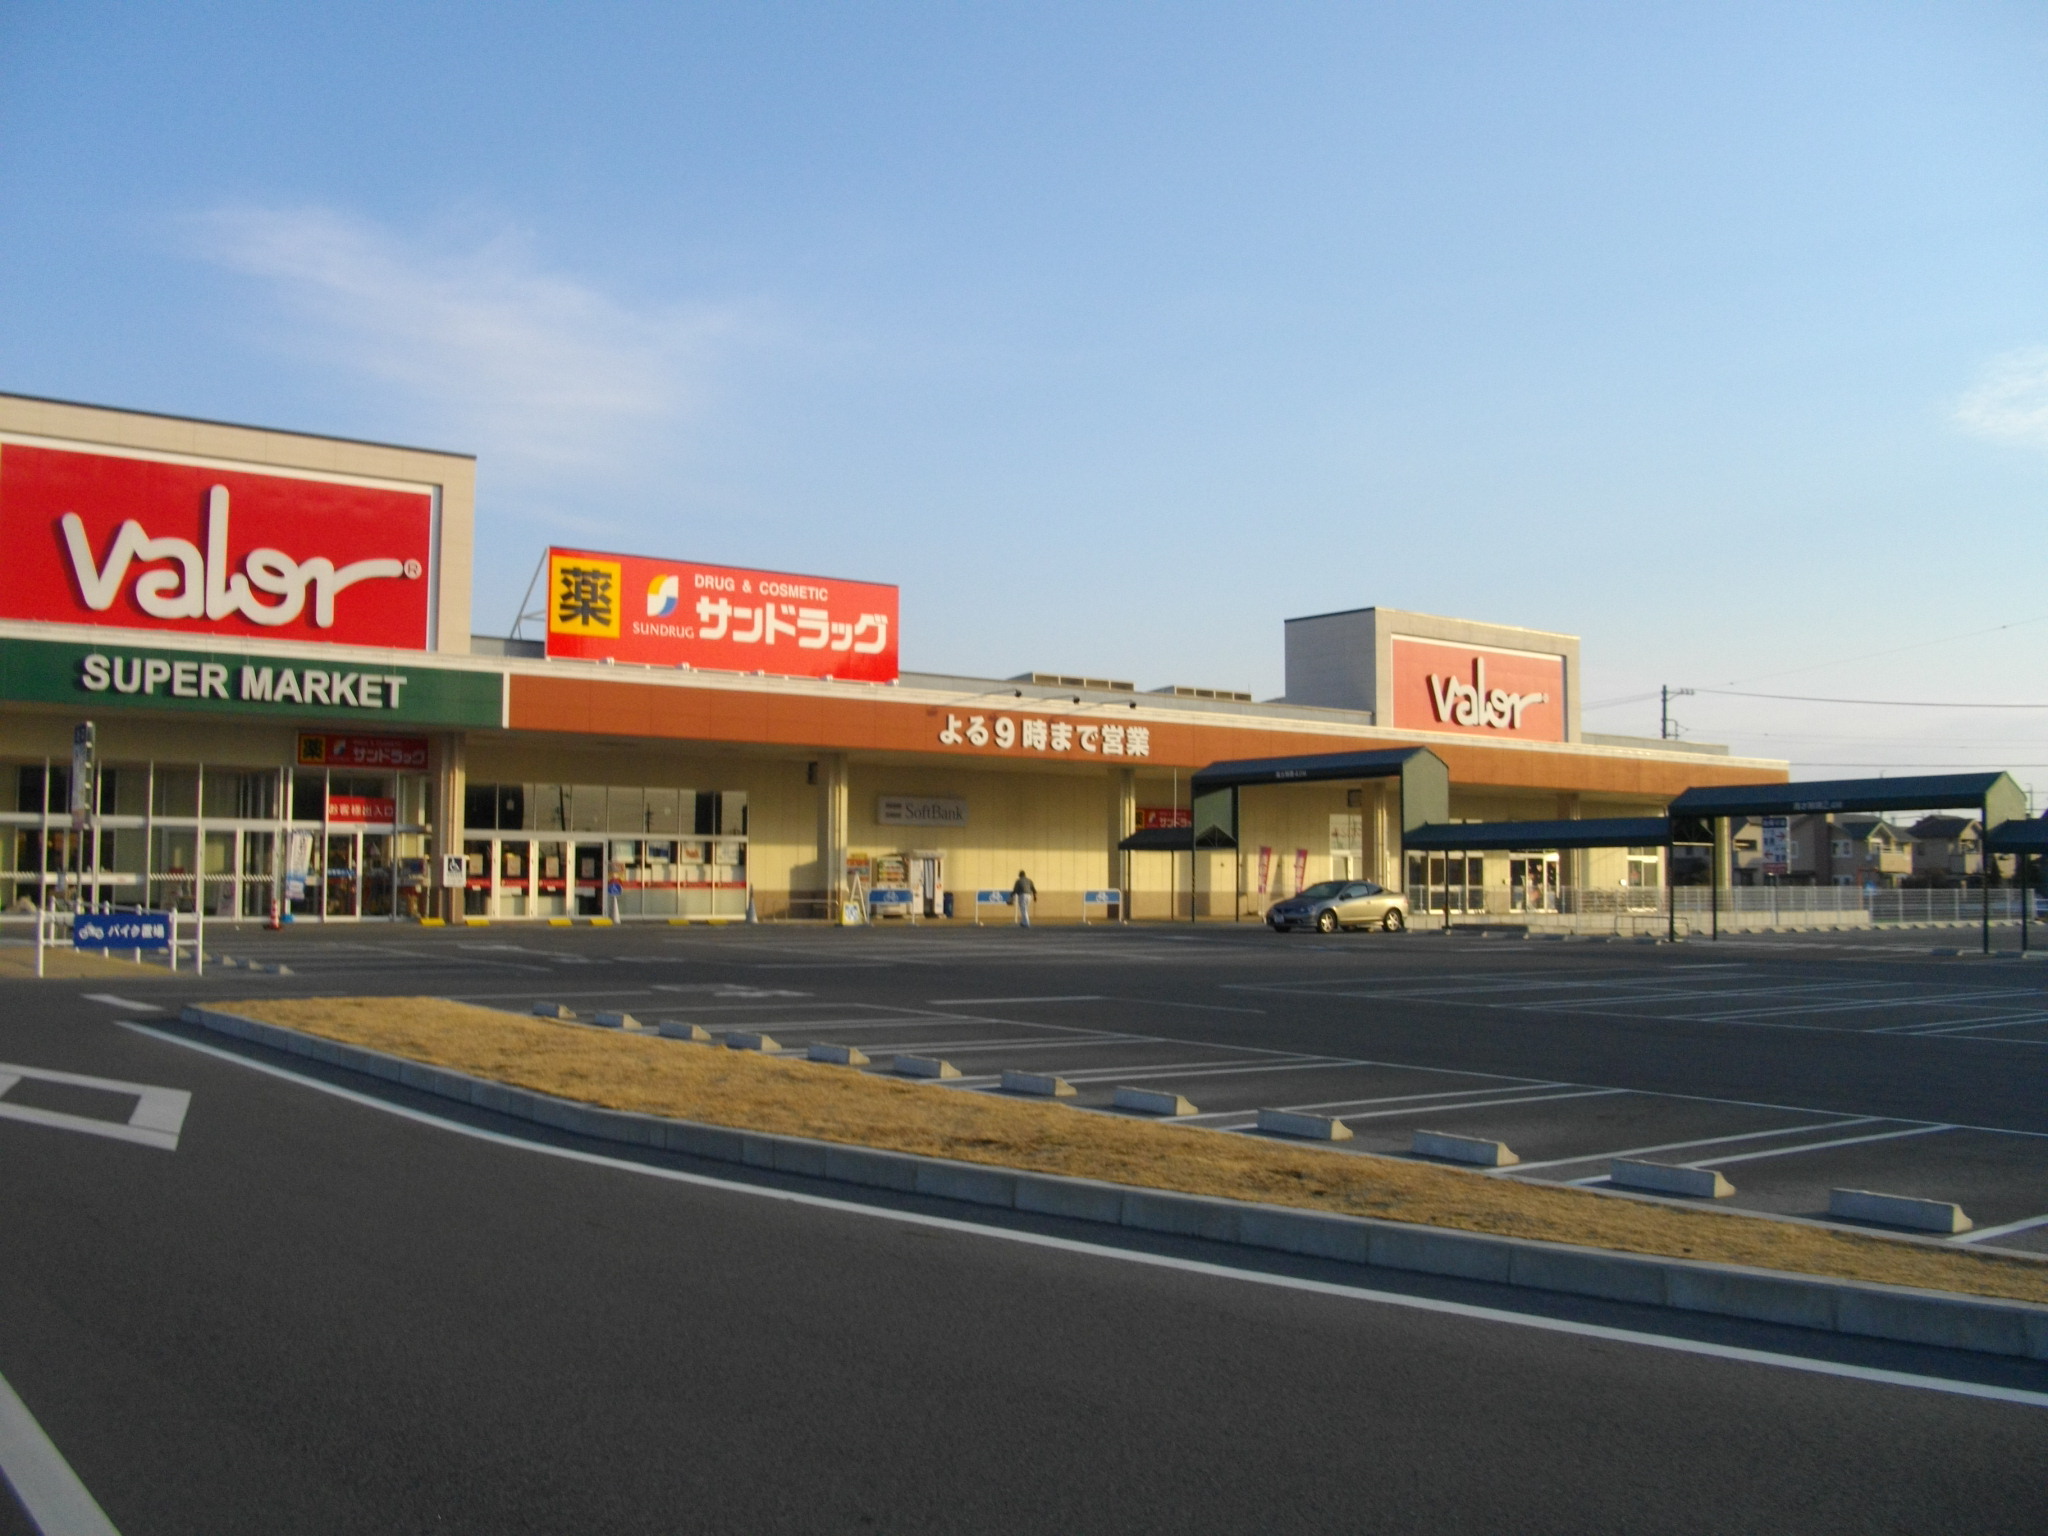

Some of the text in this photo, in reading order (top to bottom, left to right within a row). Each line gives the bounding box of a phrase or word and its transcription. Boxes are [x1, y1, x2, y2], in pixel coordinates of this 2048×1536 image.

[559, 567, 612, 626] 薬
[694, 574, 830, 602] DRUG & COSMETIC
[632, 622, 695, 641] SUNDRUG
[695, 596, 888, 655] サンドラッグ
[82, 653, 407, 709] SUPER MARKET
[939, 713, 1151, 757] よる9時まで営業
[353, 747, 426, 765] サンドラッグ
[904, 801, 963, 820] SoftBank
[108, 923, 166, 939] バイク置場
